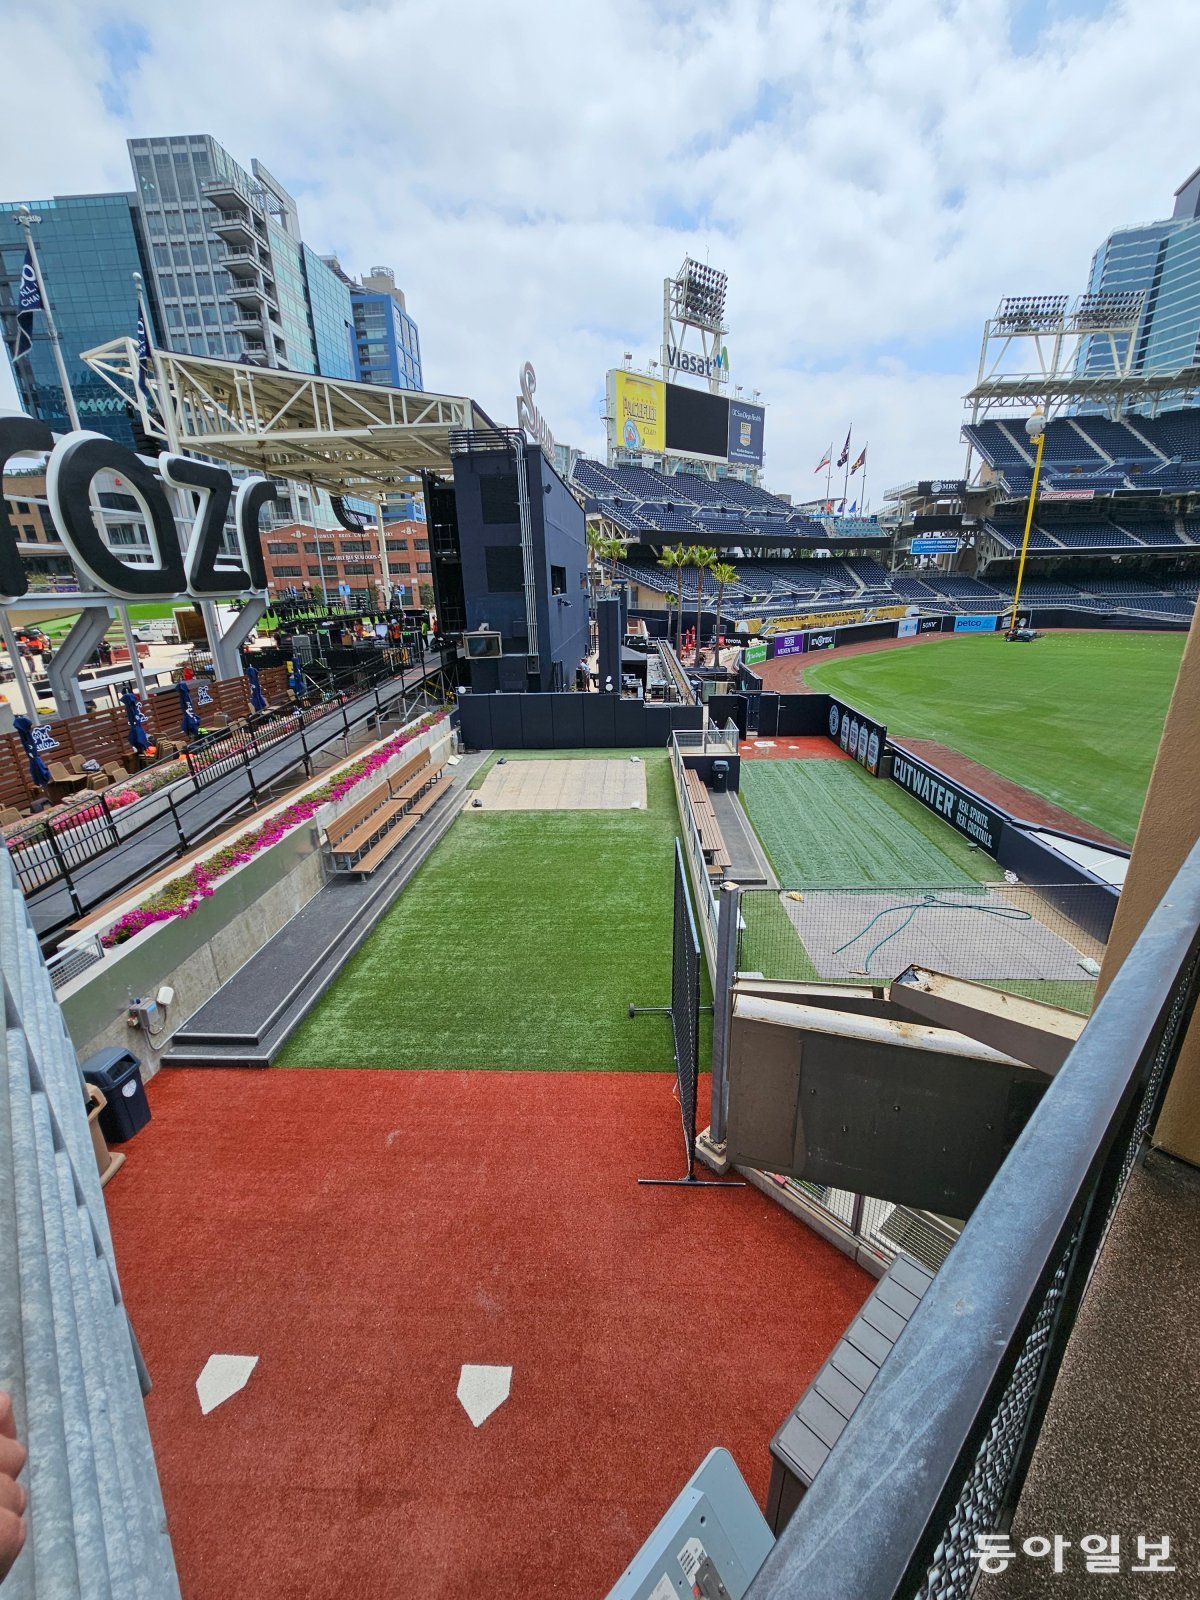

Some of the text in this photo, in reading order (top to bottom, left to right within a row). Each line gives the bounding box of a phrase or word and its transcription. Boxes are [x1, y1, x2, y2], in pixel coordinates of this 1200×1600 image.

[666, 344, 712, 377] Viasat
[922, 621, 938, 629] SONY
[957, 620, 981, 628] petco
[893, 756, 955, 818] CUTWATER
[958, 798, 970, 816] REAL
[956, 811, 967, 829] REAL
